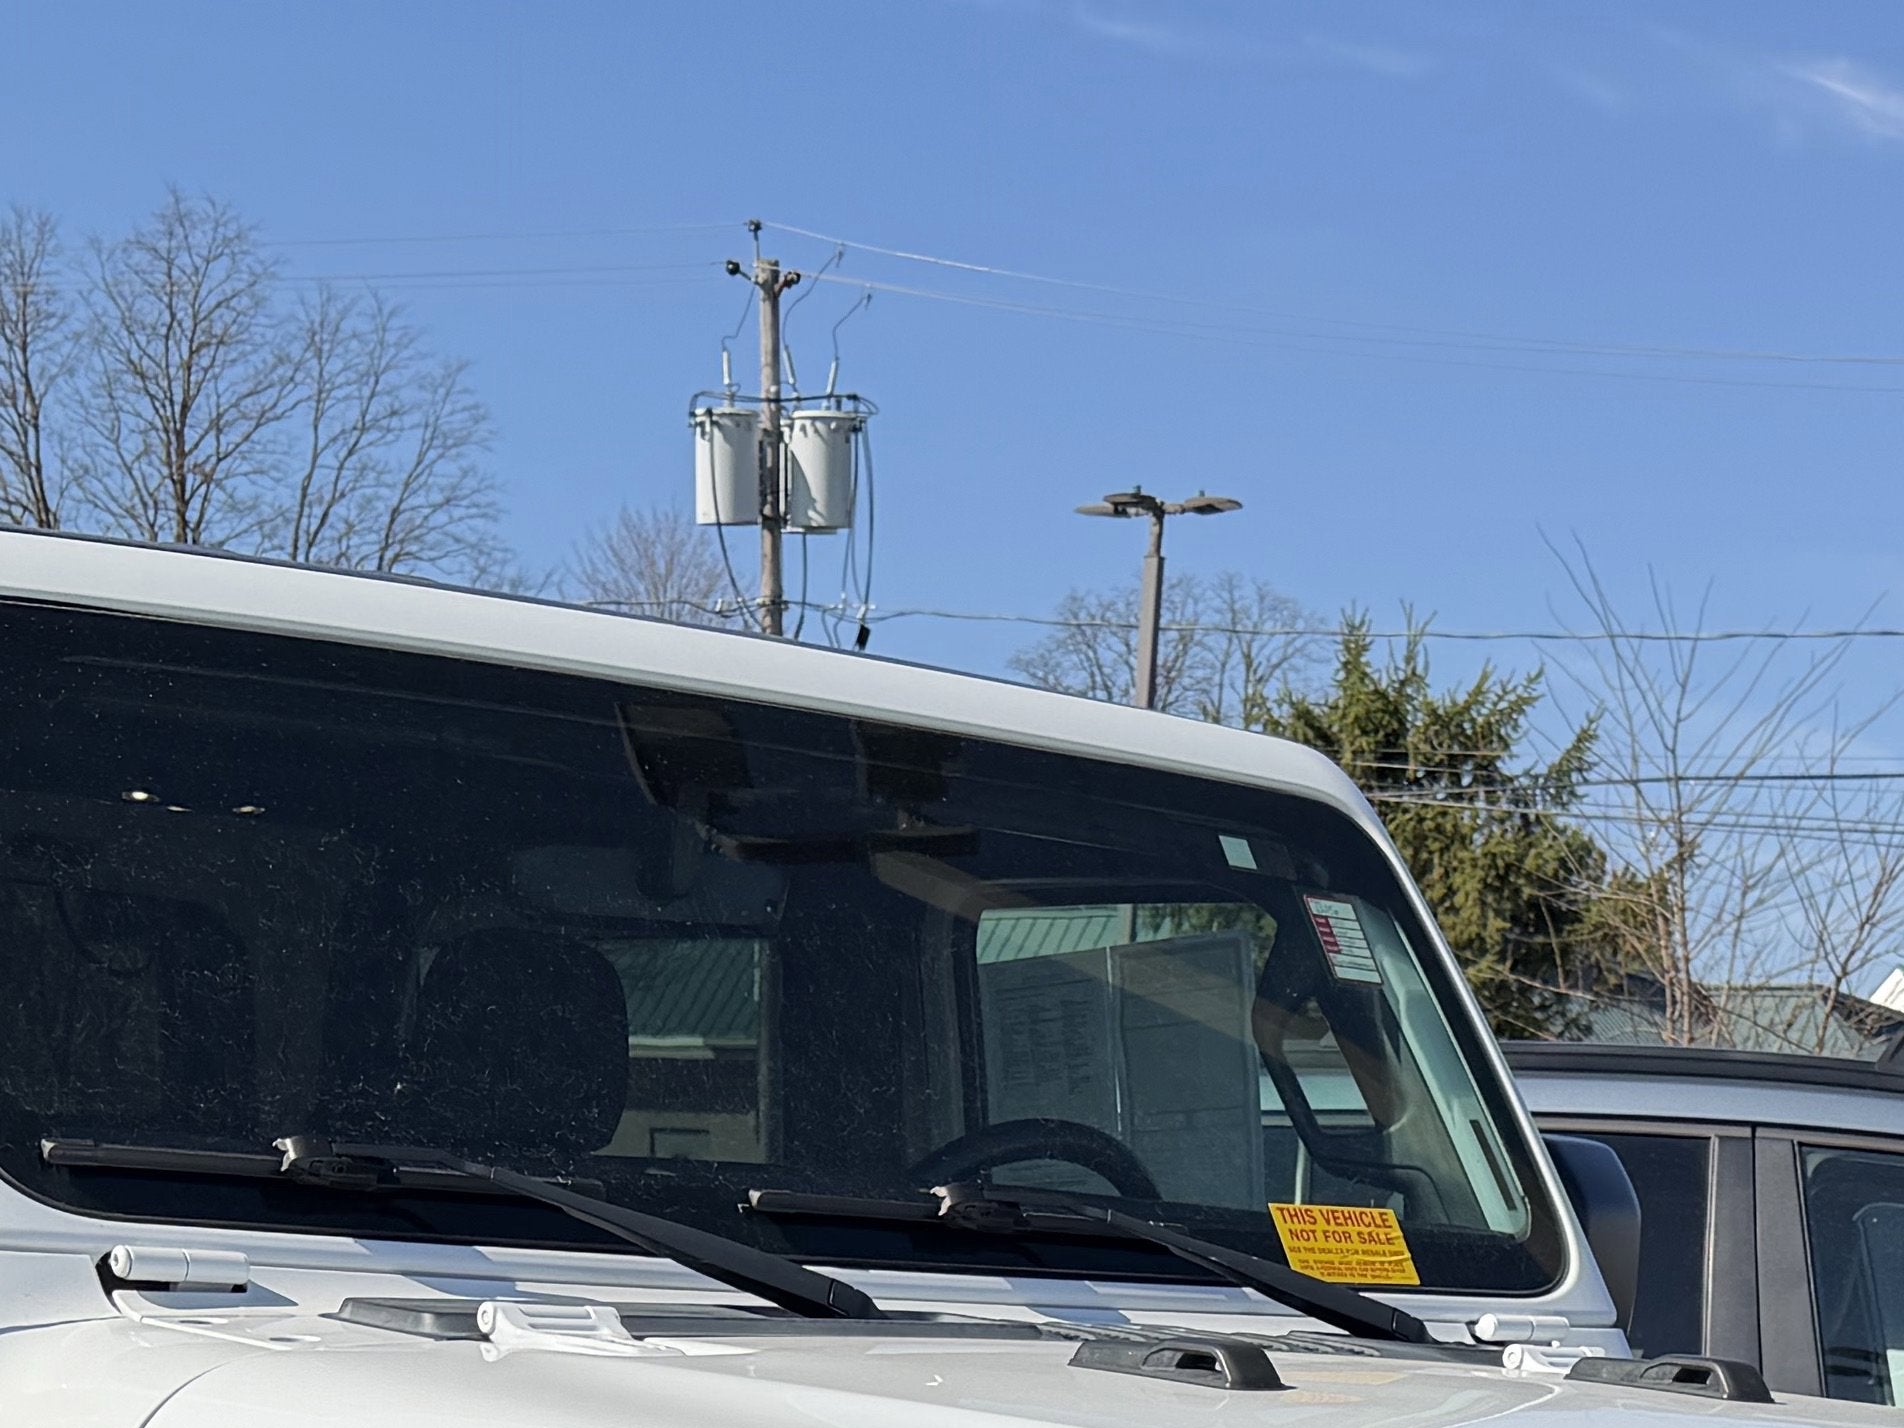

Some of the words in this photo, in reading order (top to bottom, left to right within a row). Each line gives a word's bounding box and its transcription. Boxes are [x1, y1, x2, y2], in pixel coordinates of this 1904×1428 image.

[1276, 1207, 1317, 1225] THIS
[1319, 1209, 1393, 1228] VEHICLE
[1288, 1228, 1318, 1242] NOT
[1322, 1230, 1354, 1244] FOR
[1357, 1231, 1395, 1245] SALE
